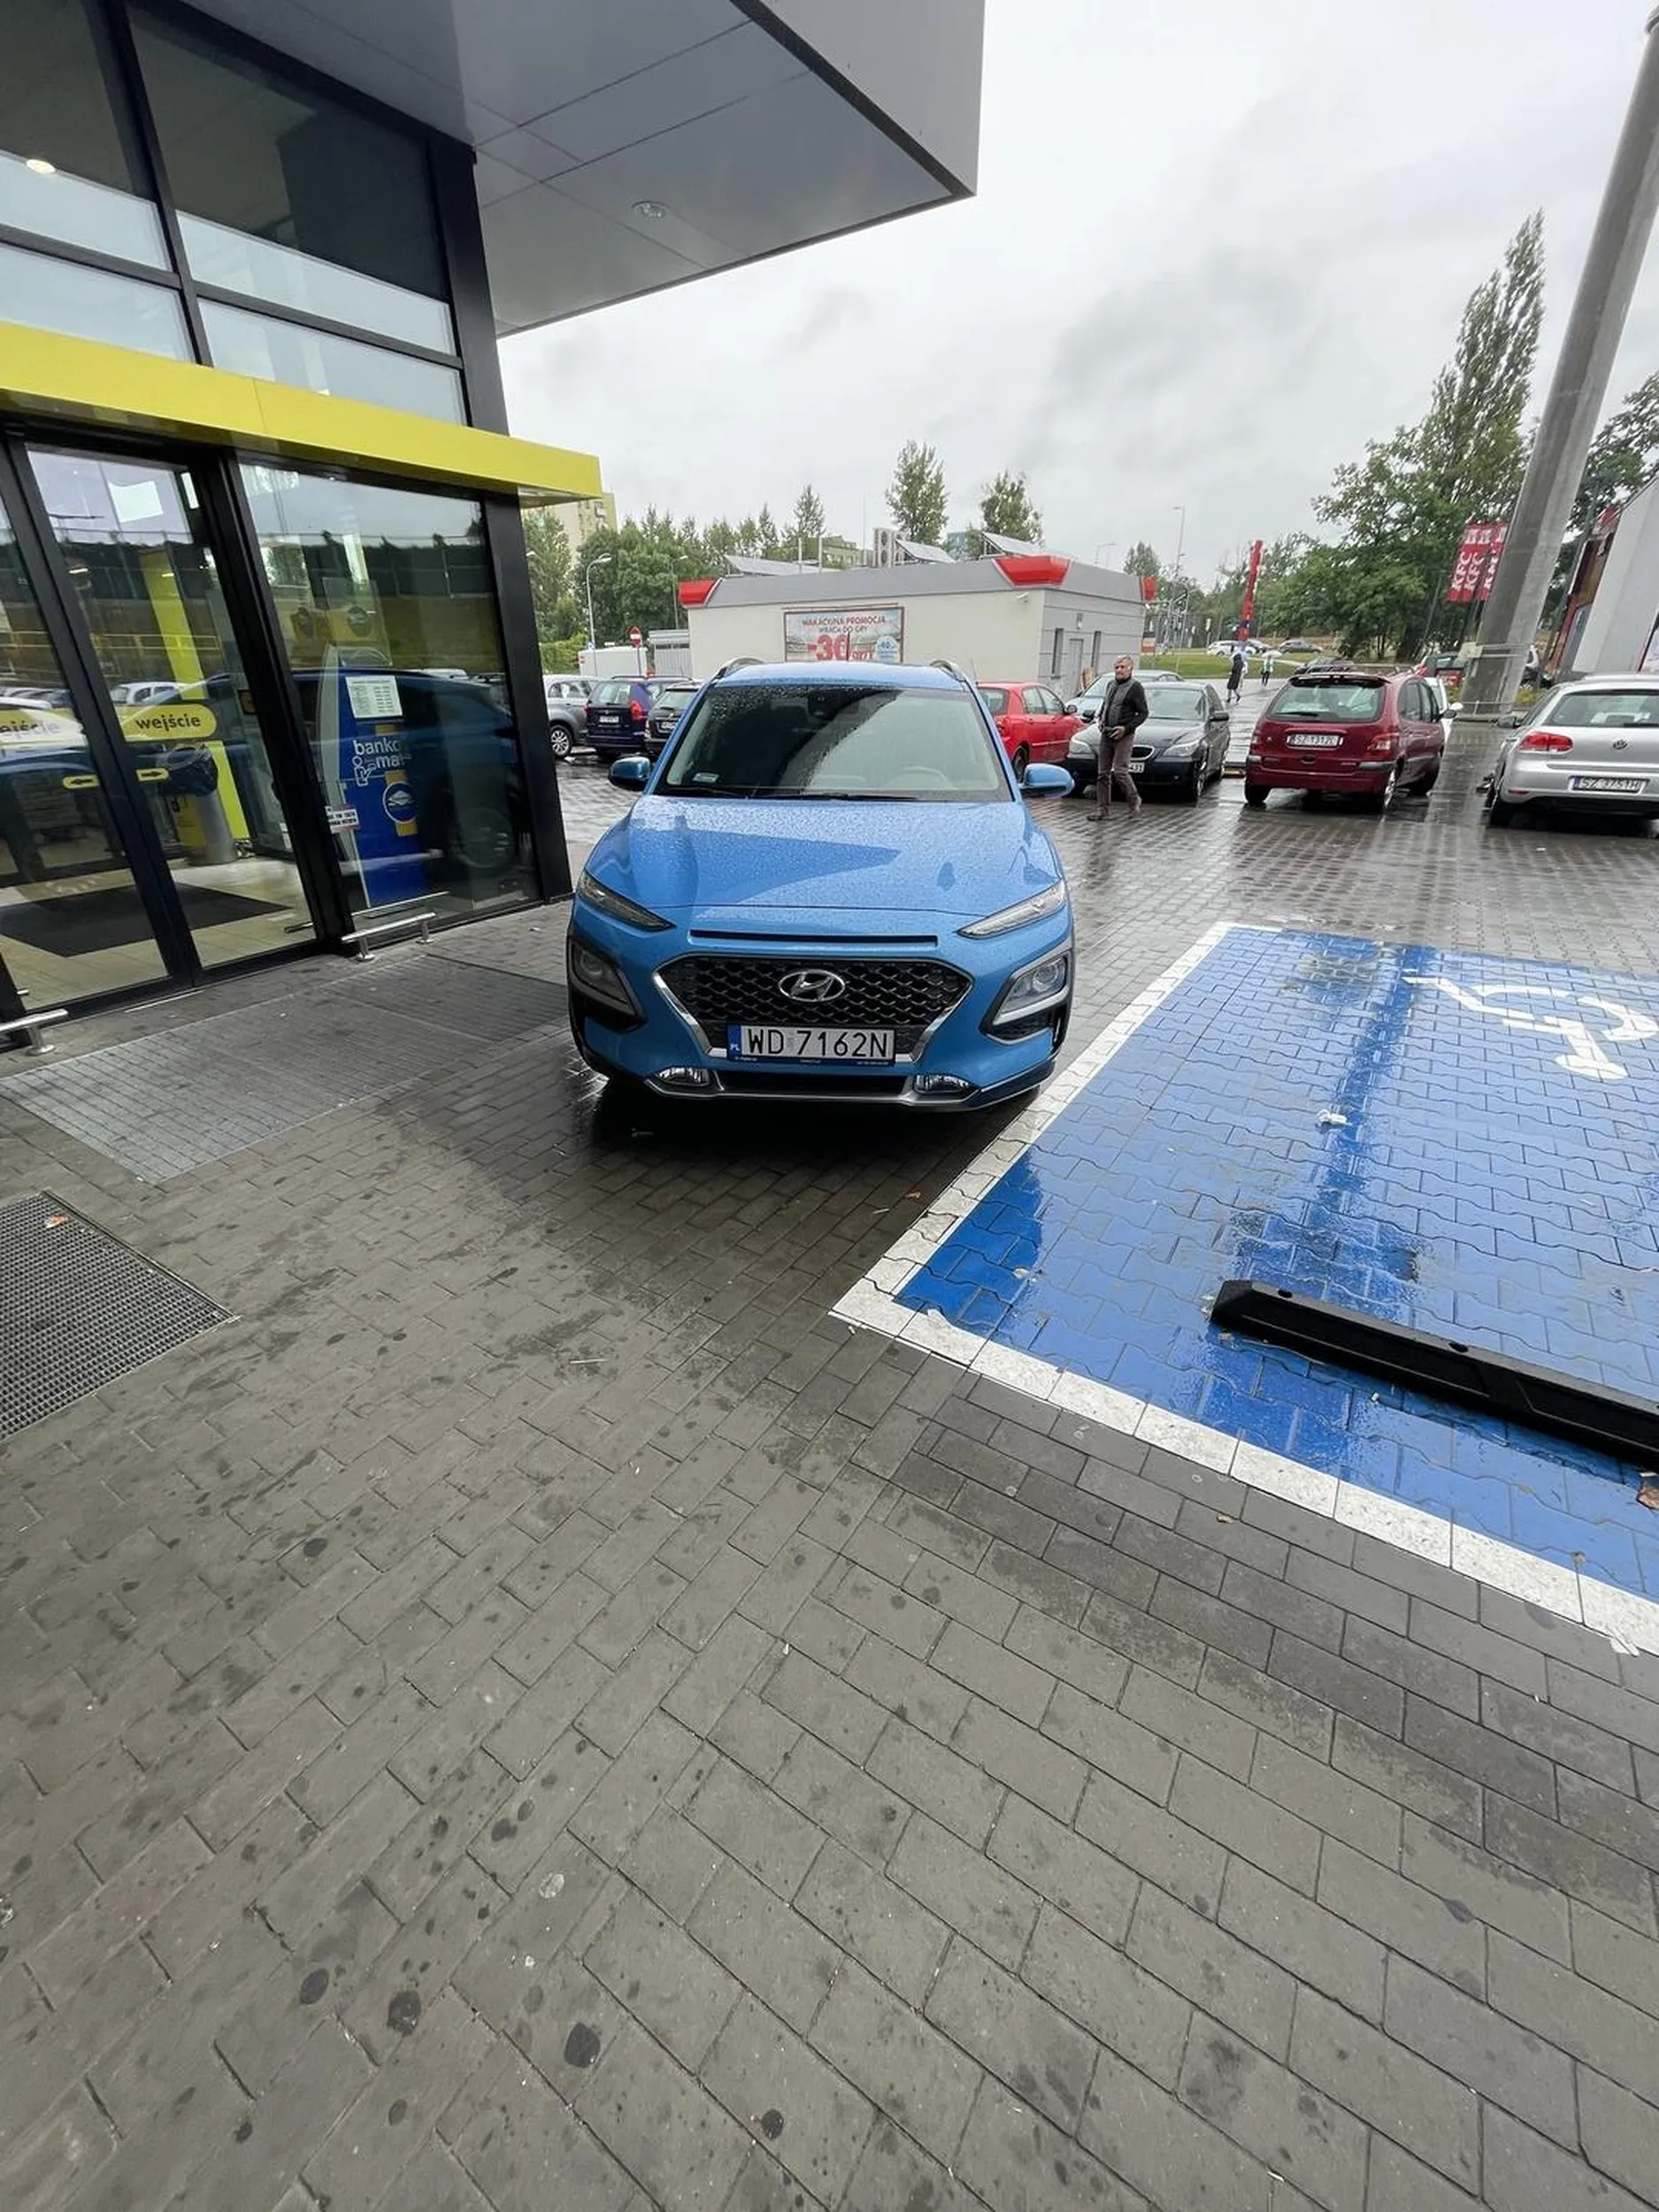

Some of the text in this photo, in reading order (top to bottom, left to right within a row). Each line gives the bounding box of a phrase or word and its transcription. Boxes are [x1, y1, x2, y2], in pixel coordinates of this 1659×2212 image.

[1452, 550, 1473, 592] KFC
[845, 616, 886, 625] PROMOCJA
[0, 719, 61, 740] ejście
[135, 713, 202, 733] wejście
[748, 1029, 887, 1057] WD 7162N
